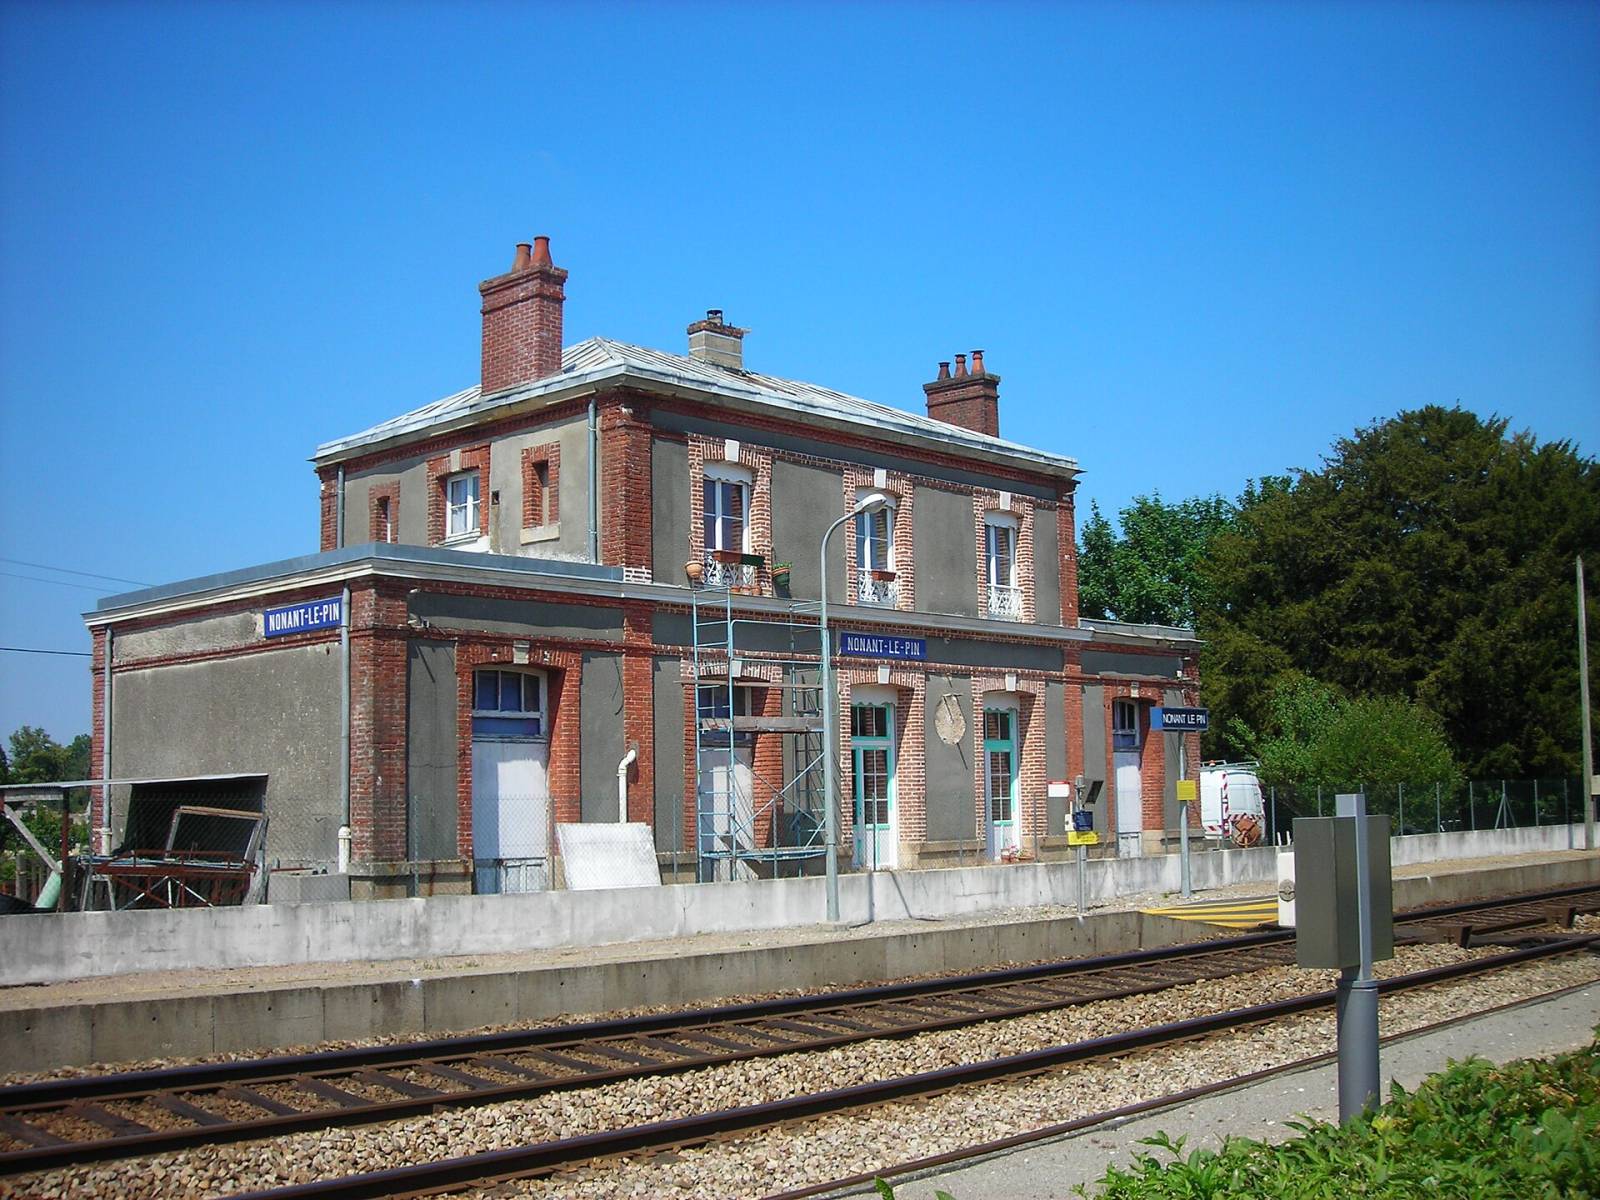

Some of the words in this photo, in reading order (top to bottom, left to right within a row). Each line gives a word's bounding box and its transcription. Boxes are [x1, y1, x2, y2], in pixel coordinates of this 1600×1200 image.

[269, 602, 339, 632] NONANT-LE-PIN
[847, 636, 920, 656] NONANT-LE-PIN
[1162, 713, 1186, 724] NONANT
[1187, 714, 1196, 724] LE
[1196, 714, 1206, 724] PIN
